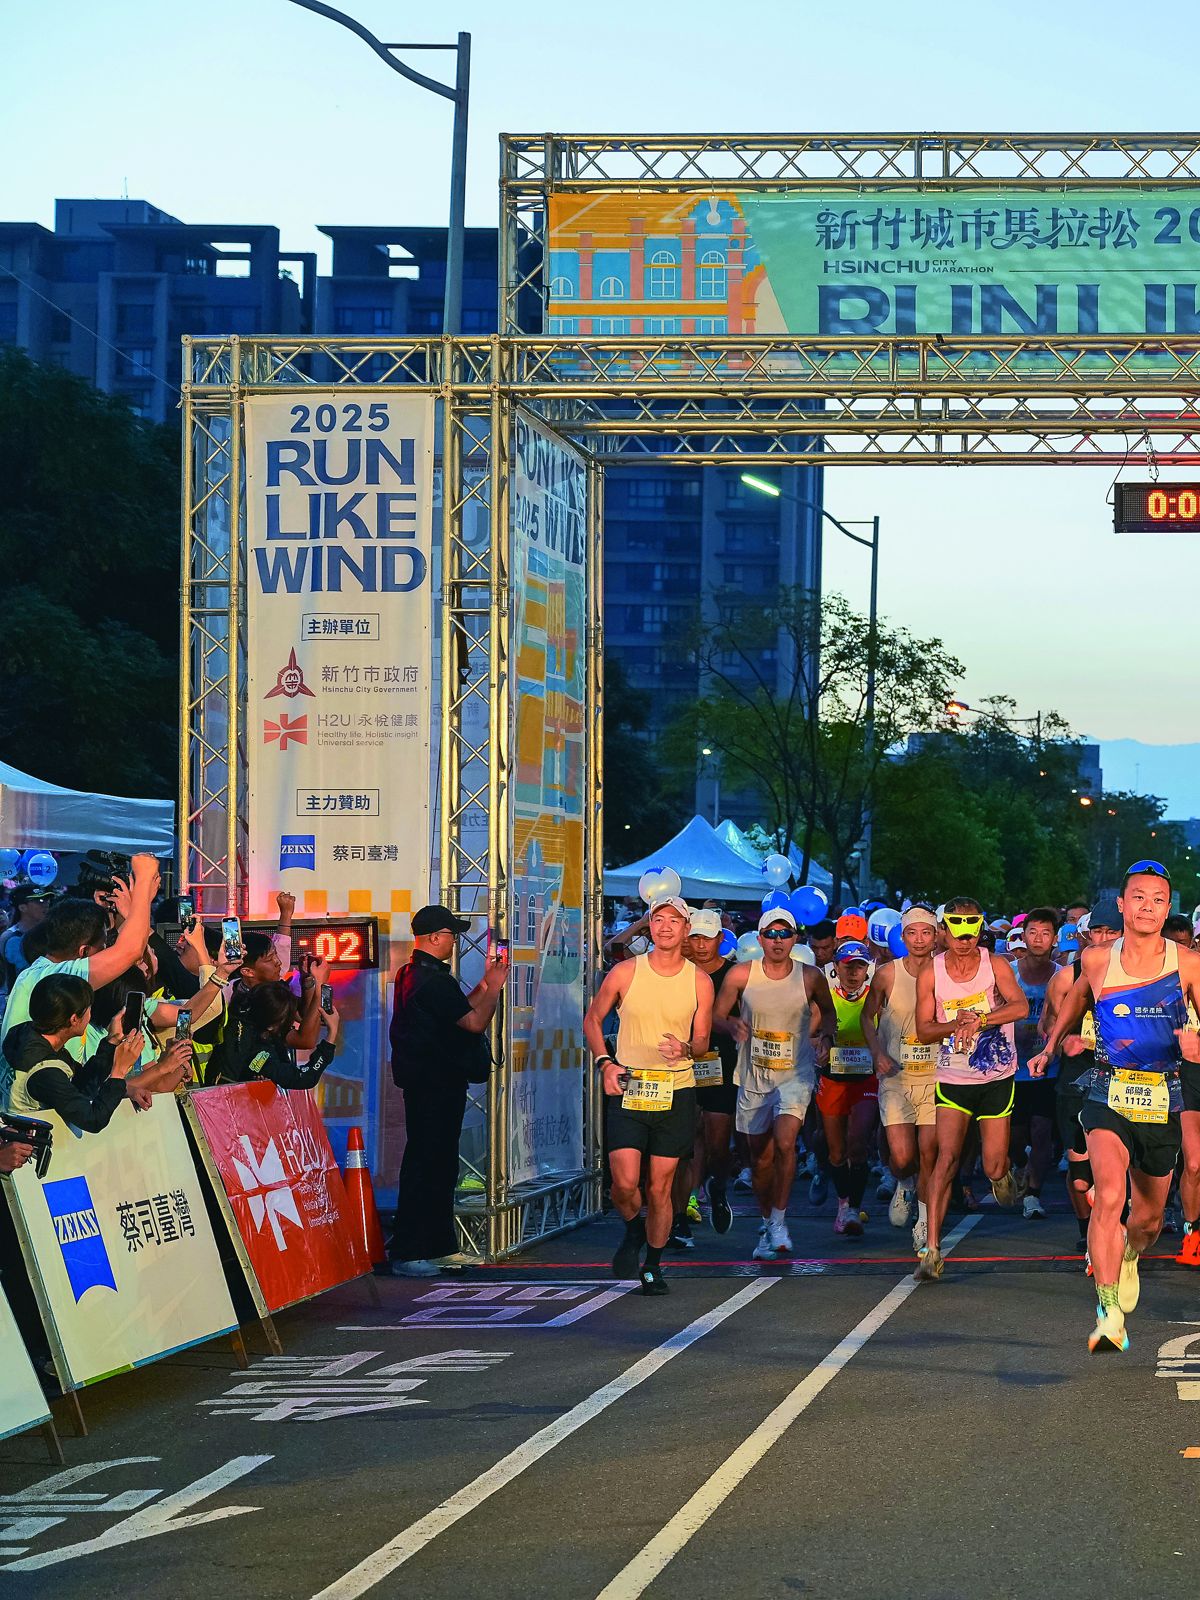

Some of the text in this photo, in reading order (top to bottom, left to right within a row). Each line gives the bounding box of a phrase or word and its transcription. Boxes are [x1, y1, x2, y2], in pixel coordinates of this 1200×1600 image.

[815, 206, 1141, 251] 新竹城市馬拉松
[823, 259, 930, 274] HSINCHU
[290, 403, 390, 433] 2025
[266, 438, 416, 487] RUN
[265, 492, 417, 541] LIKE
[253, 545, 428, 594] WIND
[307, 618, 371, 635] 主辦單位
[321, 665, 419, 682] 新竹市政府
[317, 714, 351, 727] H2U
[306, 794, 370, 811] 主力贊助
[280, 844, 315, 855] ZEISS
[333, 844, 399, 861] 蔡司臺灣
[636, 1090, 659, 1098] 10377
[1113, 1094, 1153, 1106] A 11122
[53, 1208, 100, 1245] ZEISS
[115, 1188, 196, 1254] 蔡司臺灣
